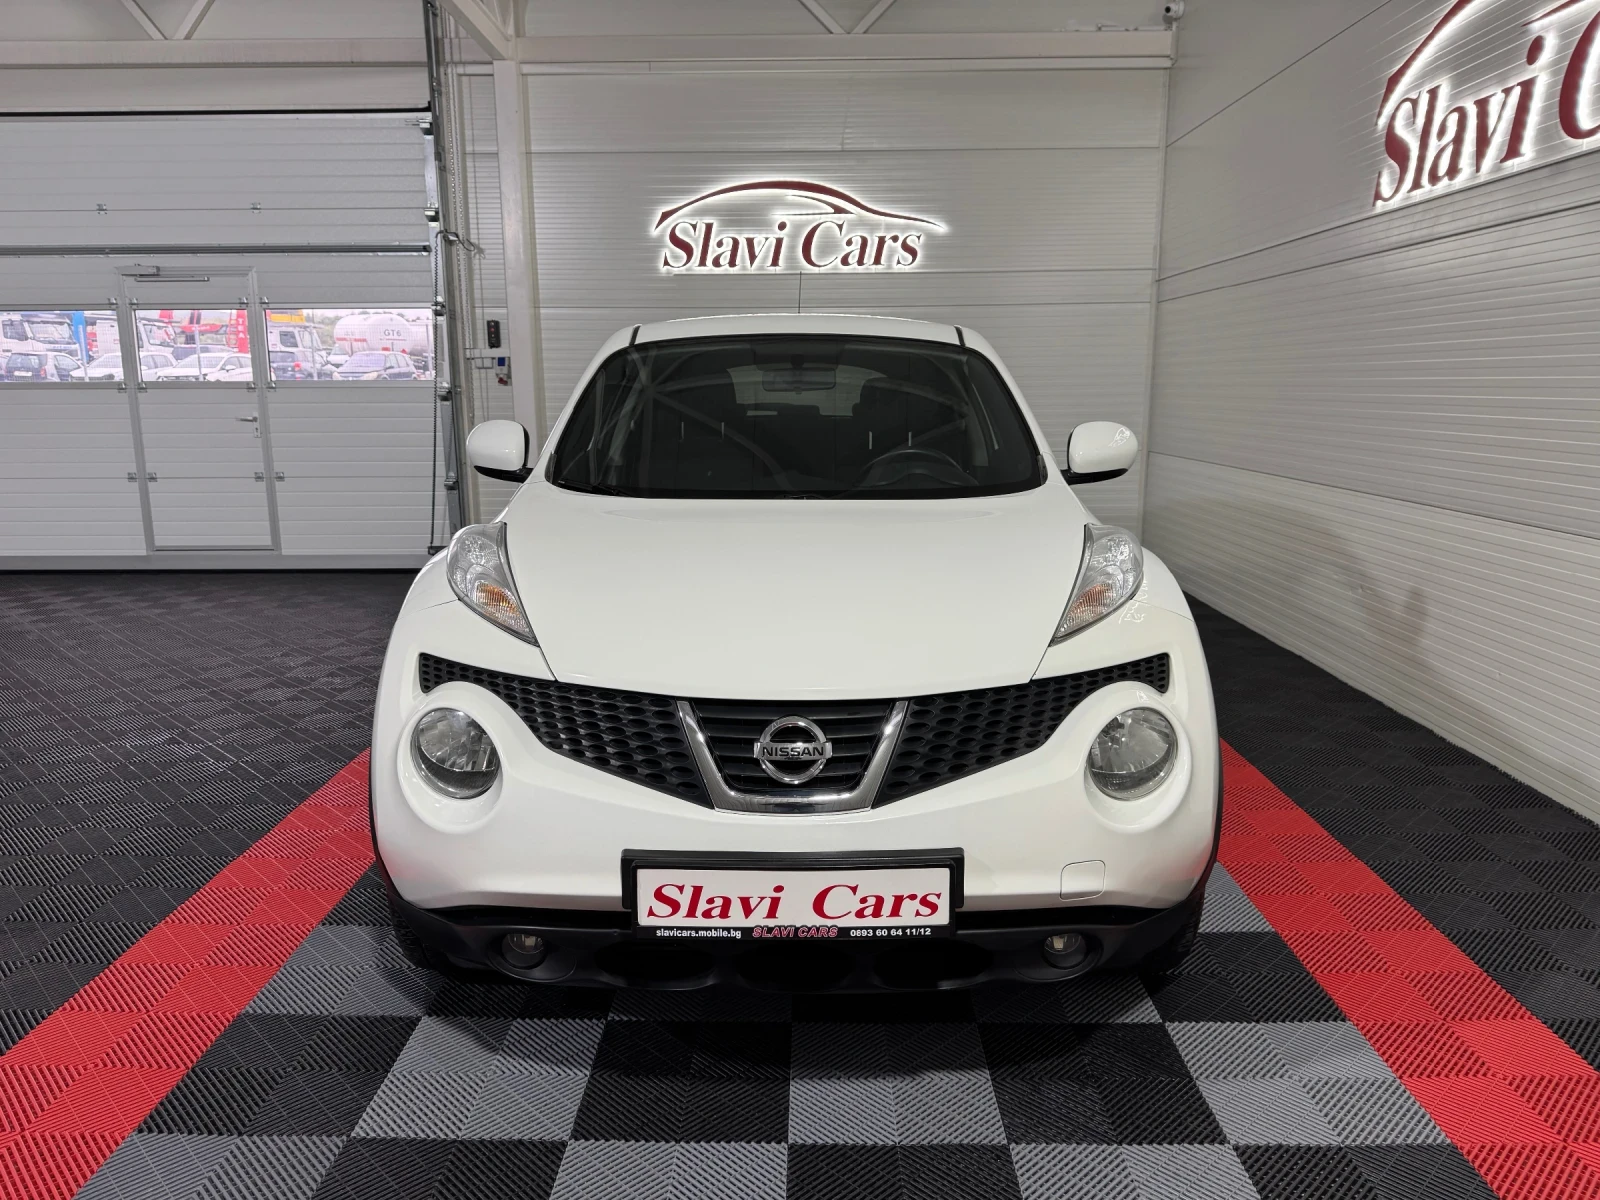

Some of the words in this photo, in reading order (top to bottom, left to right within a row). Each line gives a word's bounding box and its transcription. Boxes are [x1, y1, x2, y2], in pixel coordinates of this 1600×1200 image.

[1372, 35, 1545, 207] Slavi
[662, 220, 787, 269] Slavi
[801, 220, 922, 268] Cars
[383, 328, 402, 337] GT6
[761, 746, 824, 758] NISSAN
[646, 883, 785, 920] Slavi
[811, 883, 942, 920] Cars
[656, 928, 742, 939] slavicars.mobile.bg
[752, 926, 796, 938] SLAVI
[797, 926, 839, 938] CARS
[850, 928, 874, 937] 0893
[875, 928, 888, 937] 60
[890, 928, 903, 937] 64
[905, 927, 932, 936] 11/12
